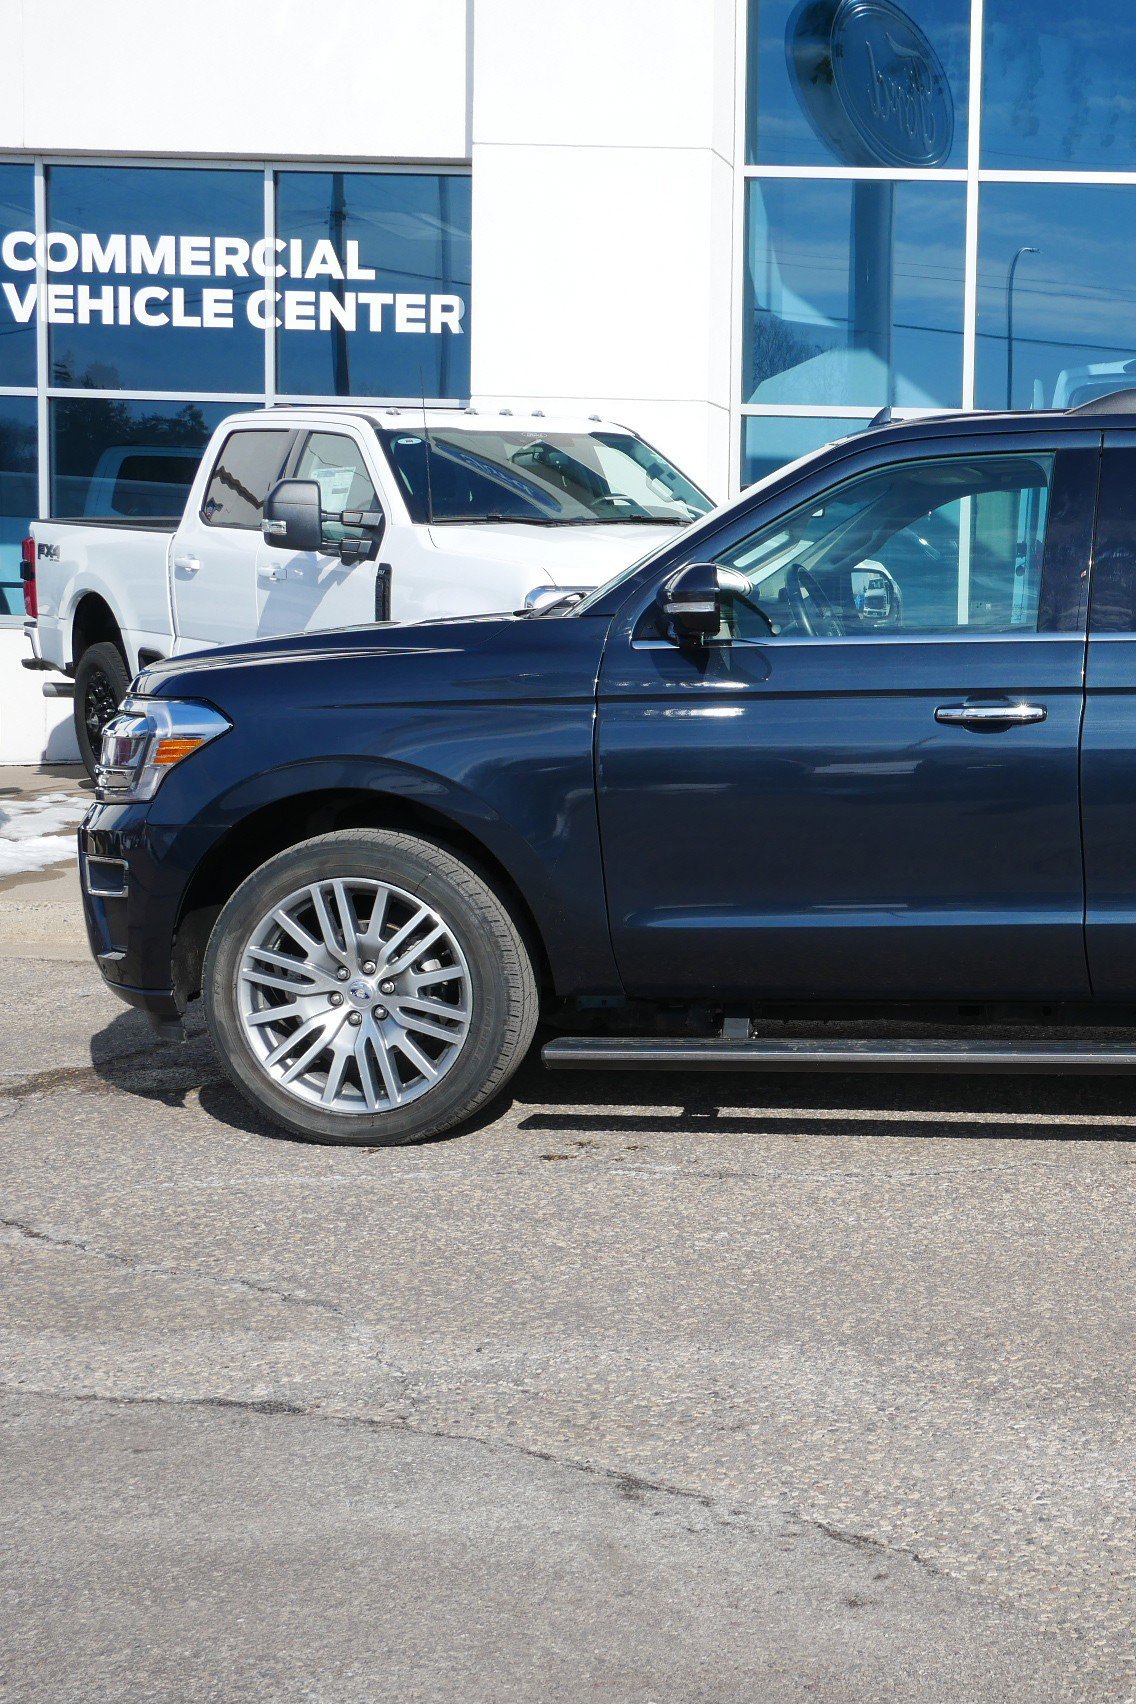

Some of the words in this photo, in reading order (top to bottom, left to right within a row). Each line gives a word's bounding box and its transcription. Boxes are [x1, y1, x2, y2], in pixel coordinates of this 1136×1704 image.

[2, 231, 376, 280] COMMERCIAL
[2, 283, 234, 328] VEHICLE
[247, 289, 465, 334] CENTER
[38, 543, 60, 559] FX4
